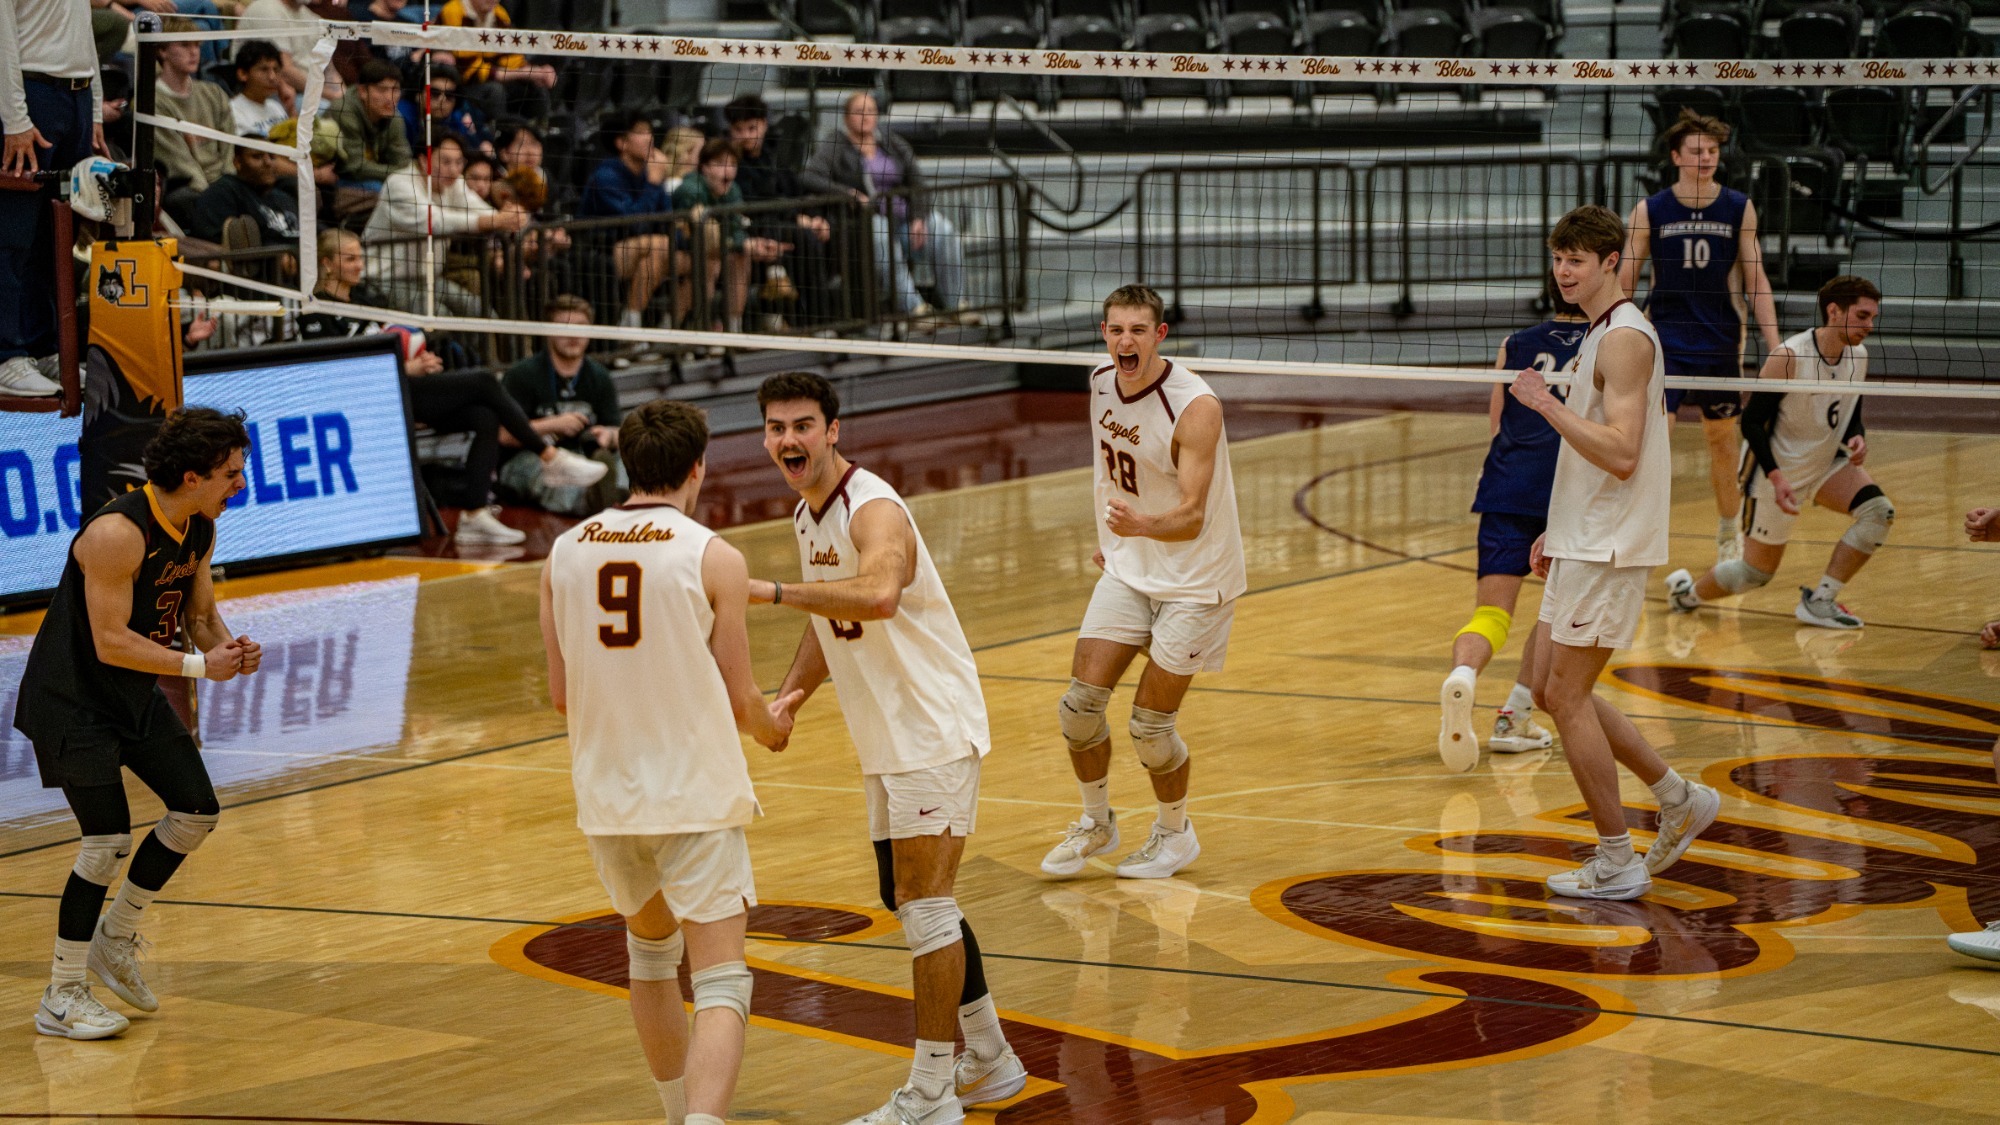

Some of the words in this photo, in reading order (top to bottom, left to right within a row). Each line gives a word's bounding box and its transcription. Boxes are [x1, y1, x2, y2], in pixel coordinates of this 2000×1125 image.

[1682, 238, 1711, 269] 10
[1099, 409, 1140, 446] Loyola
[1827, 400, 1841, 430] 6
[1100, 438, 1140, 498] 28
[577, 521, 675, 543] Ramblers
[597, 560, 643, 650] 9
